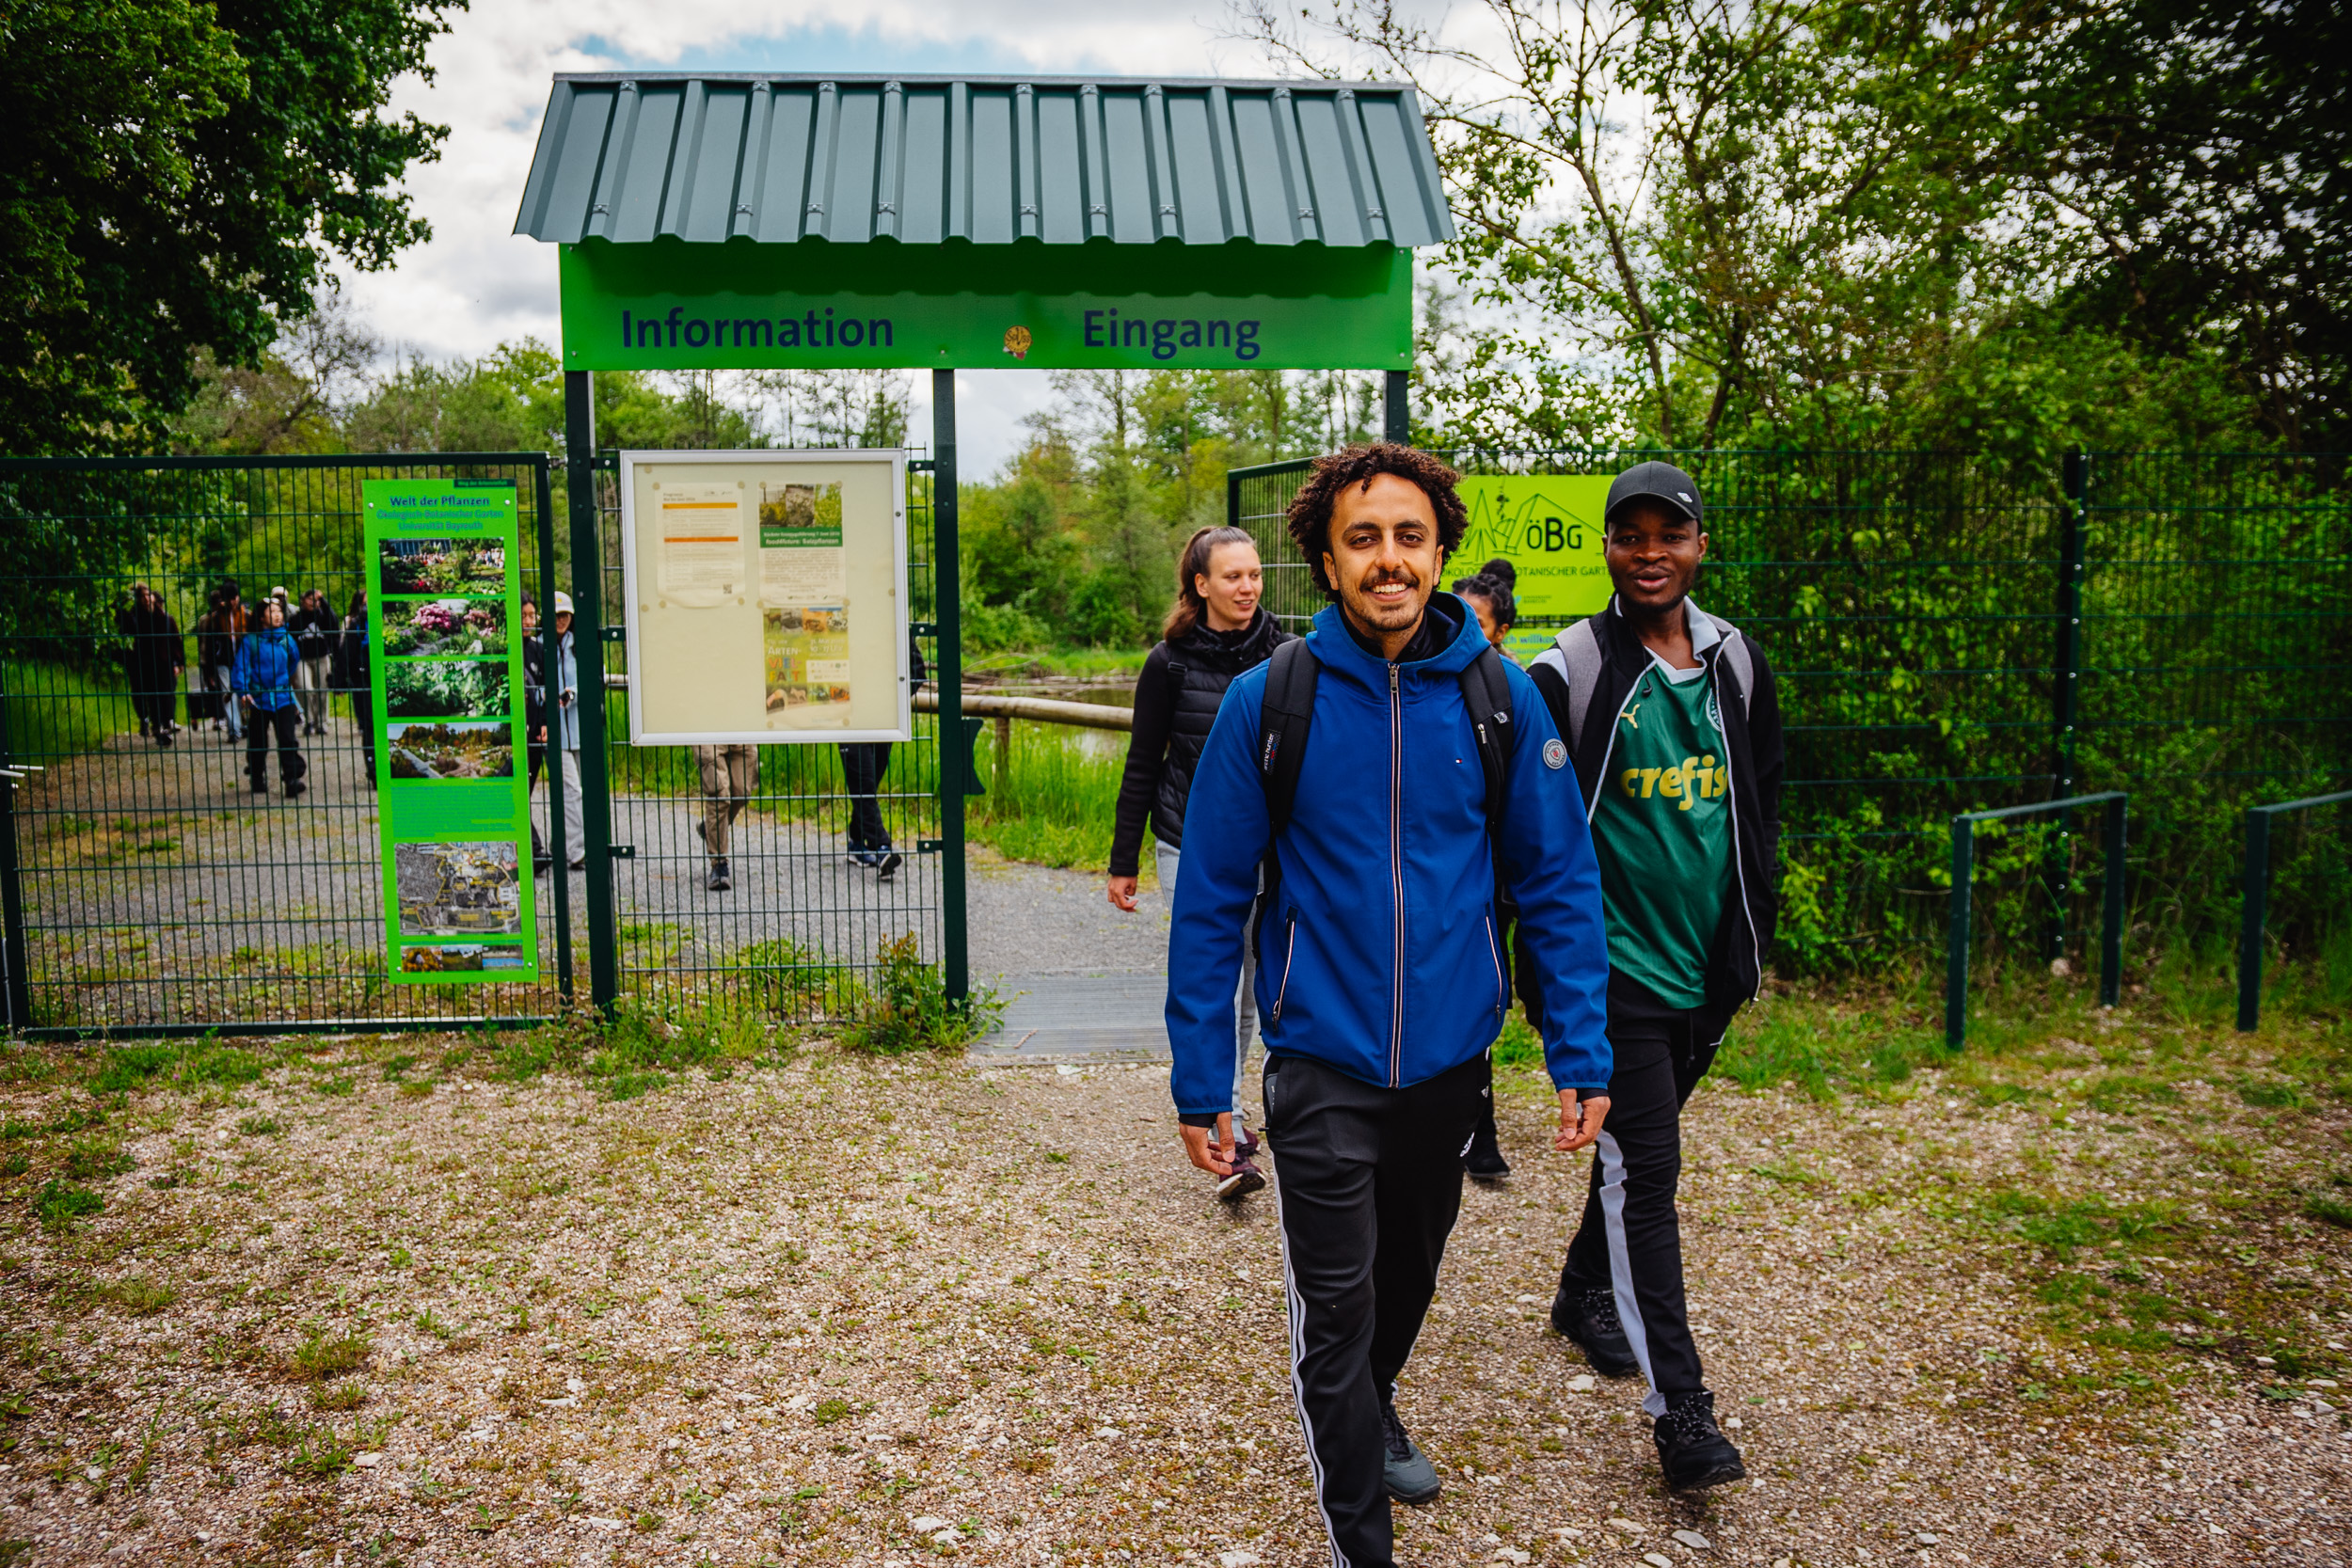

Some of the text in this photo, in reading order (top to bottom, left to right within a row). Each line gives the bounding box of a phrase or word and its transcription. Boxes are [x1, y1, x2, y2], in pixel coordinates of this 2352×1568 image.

[622, 307, 894, 348] Information
[1084, 308, 1261, 360] Eingang
[389, 495, 489, 506] Welt der Pflanzen
[474, 509, 504, 518] Garten
[1516, 565, 1578, 576] OTANISCHER
[1581, 565, 1610, 576] GART
[1519, 634, 1555, 644] willko
[769, 657, 803, 669] VIEL-
[769, 671, 800, 682] FALT
[1621, 754, 1727, 811] crefis
